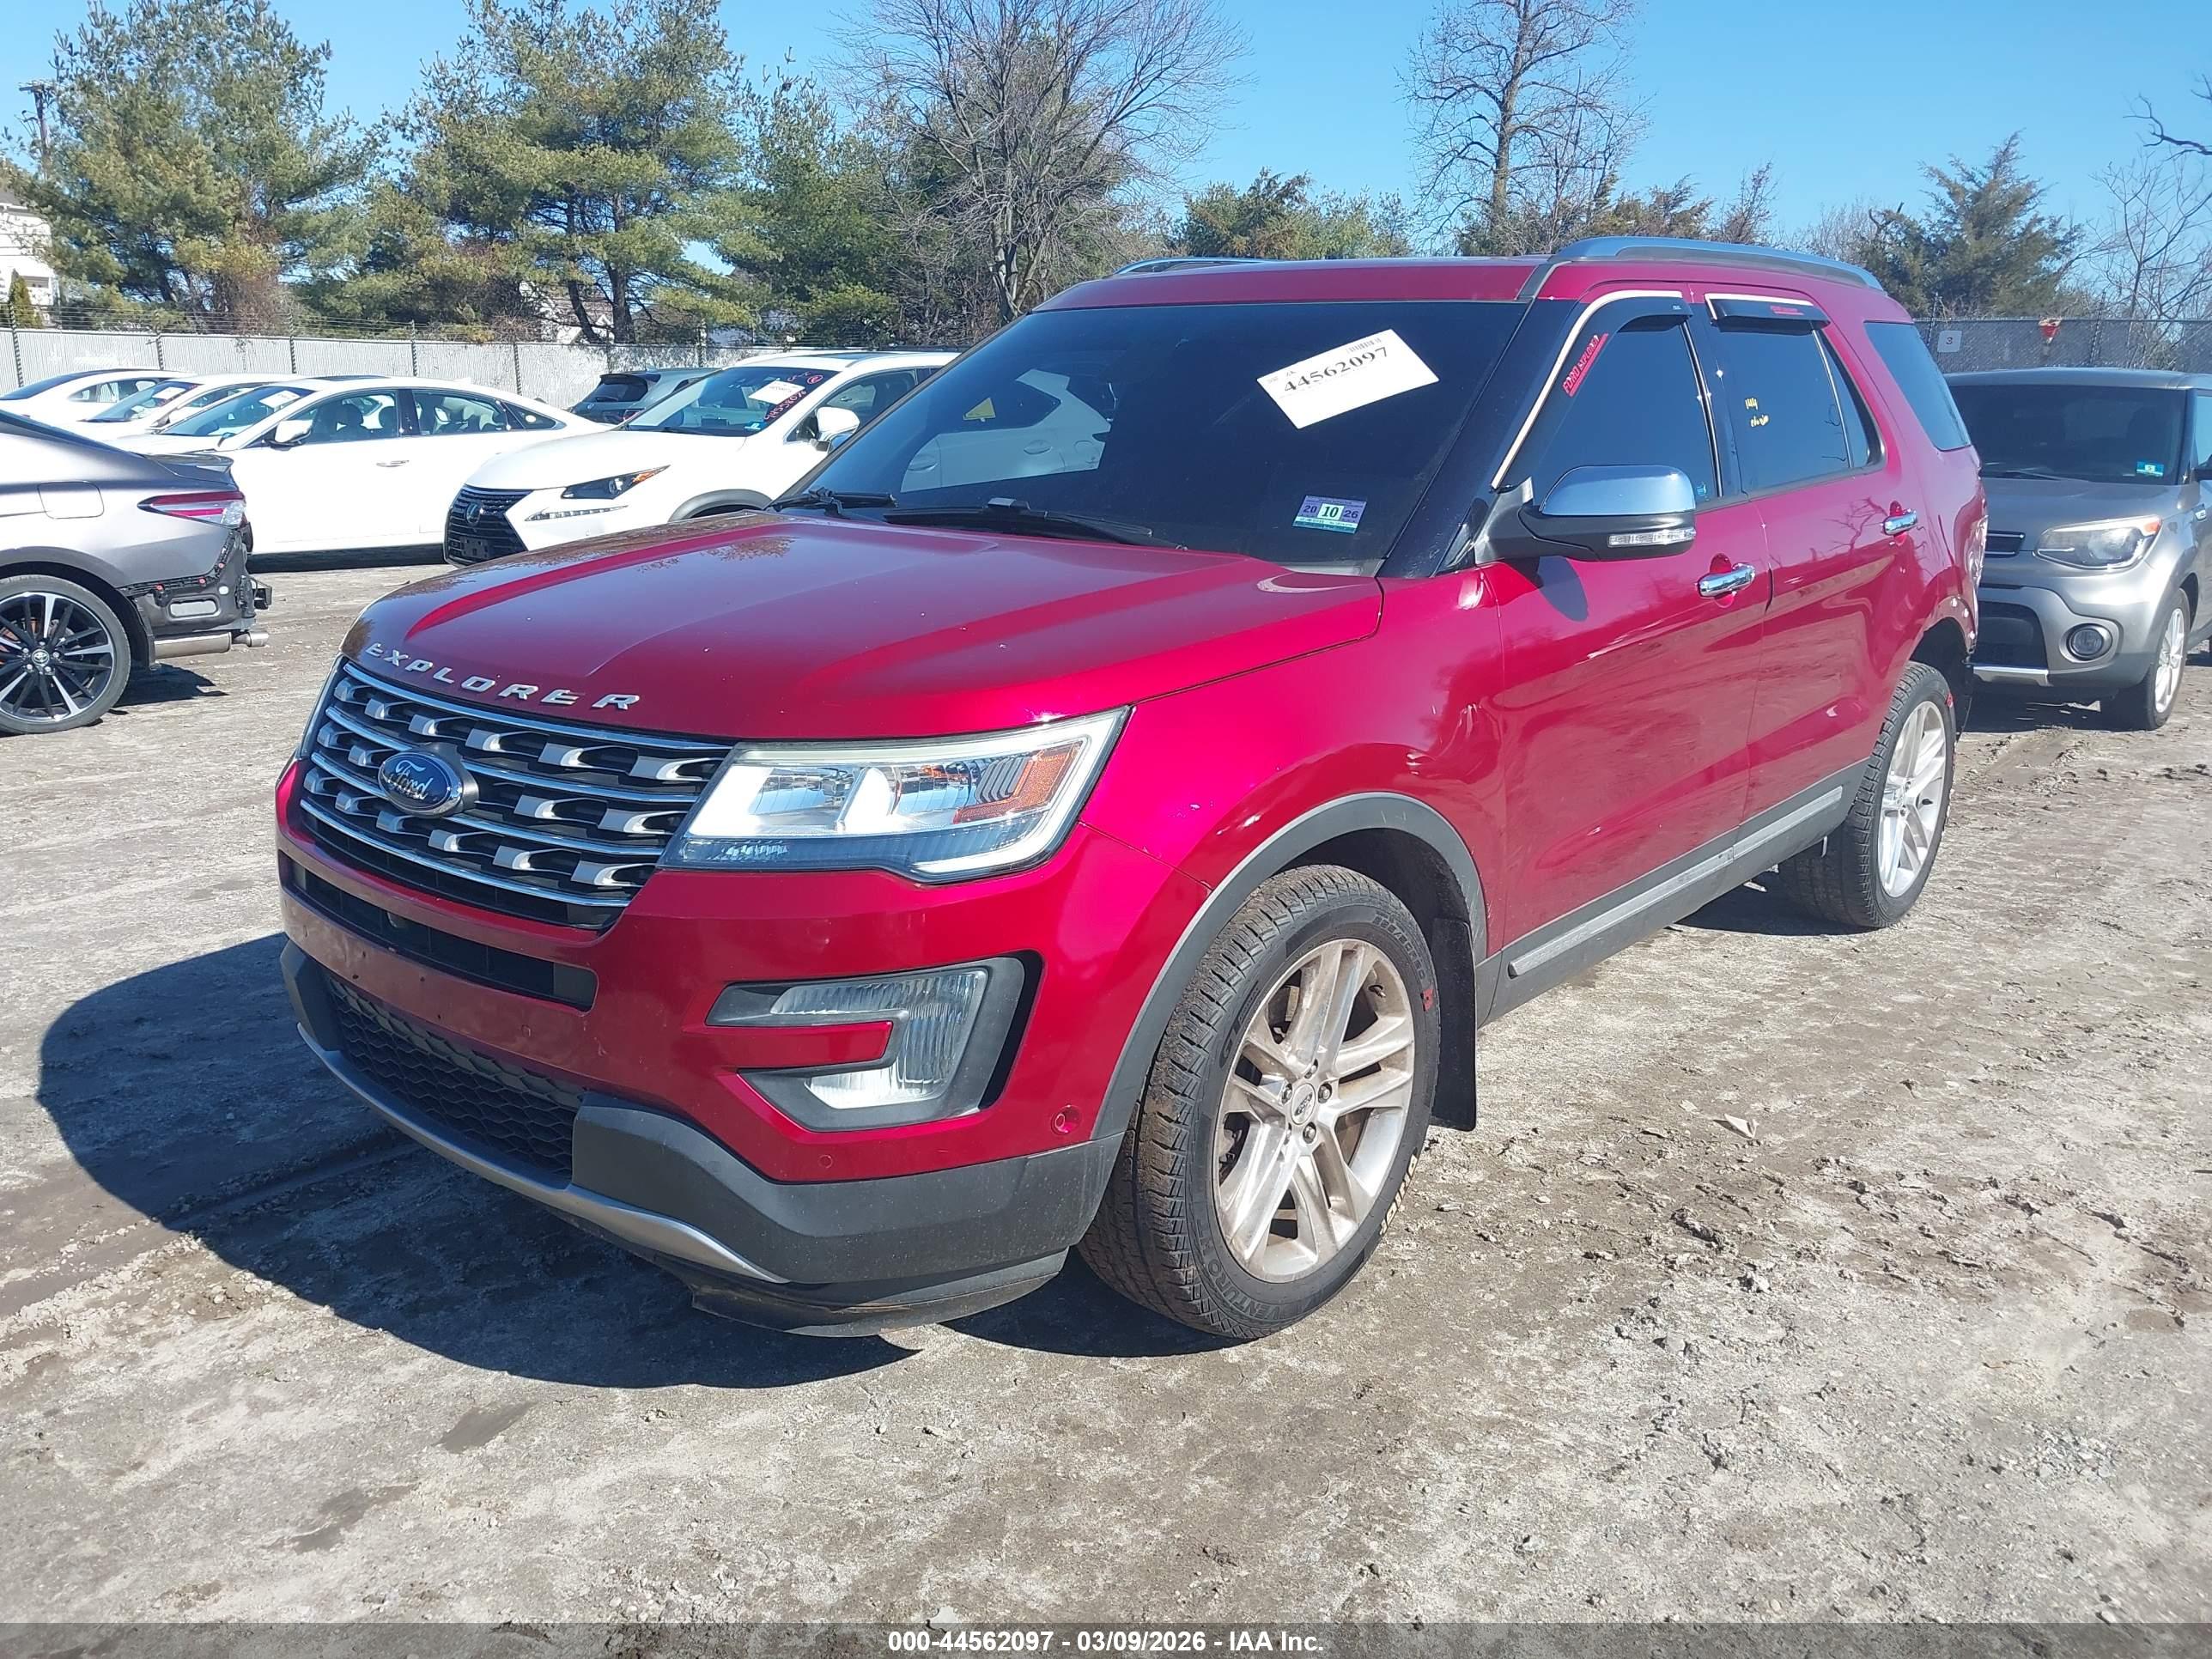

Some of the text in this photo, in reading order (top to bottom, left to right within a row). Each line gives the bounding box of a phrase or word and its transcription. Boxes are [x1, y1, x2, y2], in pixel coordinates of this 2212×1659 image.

[1946, 336, 1954, 345] 3
[1284, 346, 1388, 392] 44562097
[1303, 505, 1359, 519] 20 10 26
[365, 642, 641, 711] EXPLORER
[390, 760, 434, 800] Ford
